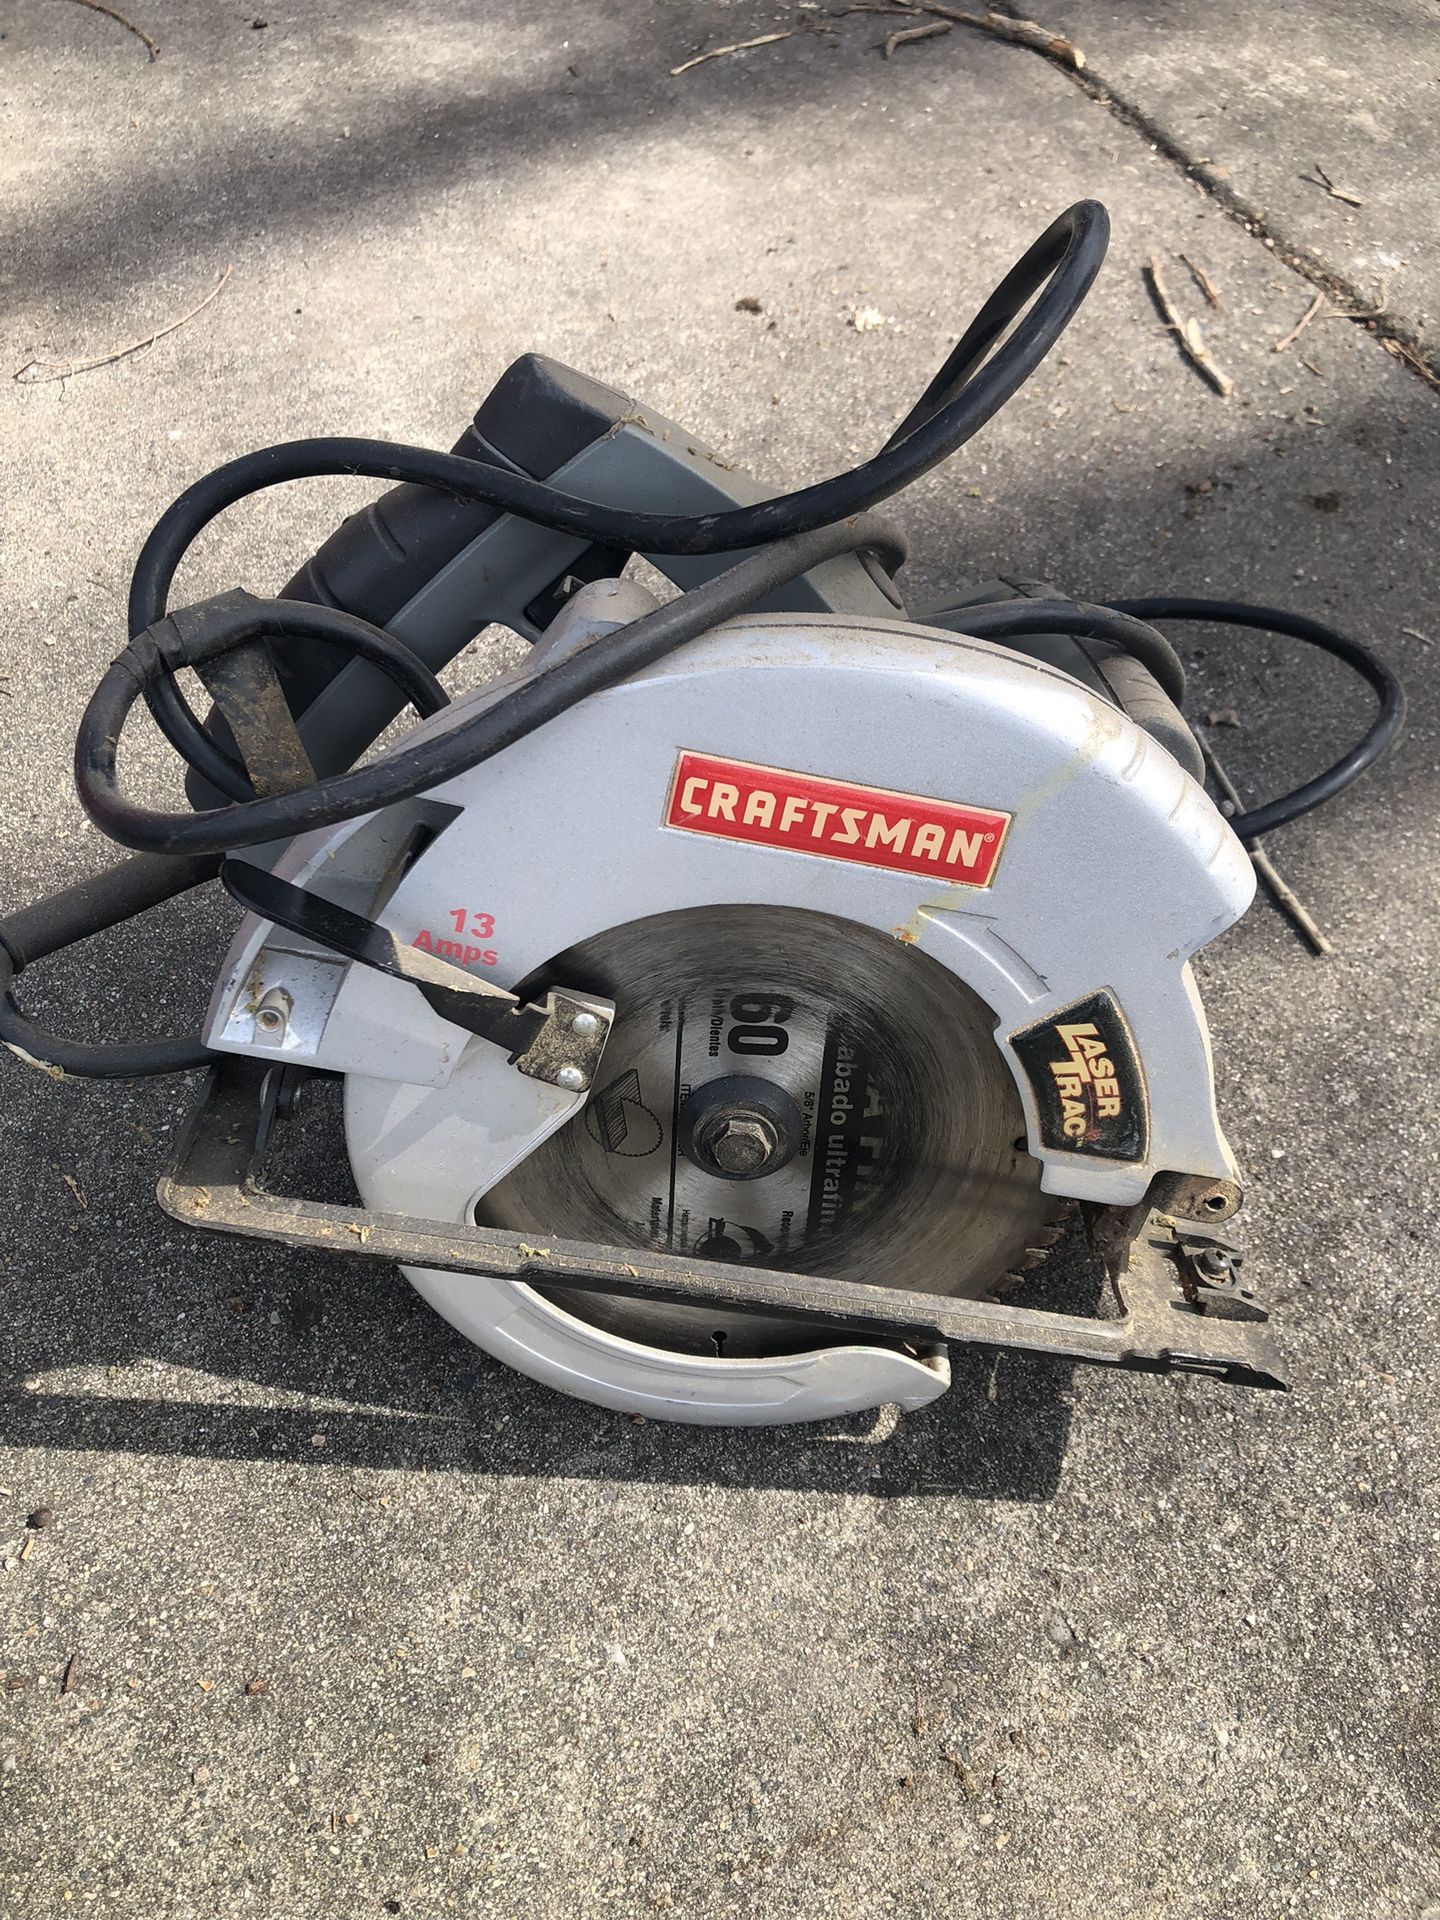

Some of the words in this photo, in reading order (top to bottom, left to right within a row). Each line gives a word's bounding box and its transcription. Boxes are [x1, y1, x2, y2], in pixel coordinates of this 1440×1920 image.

[411, 929, 498, 967] Amps
[449, 908, 496, 939] 13
[728, 993, 794, 1056] 60
[1055, 1022, 1122, 1118] LASER
